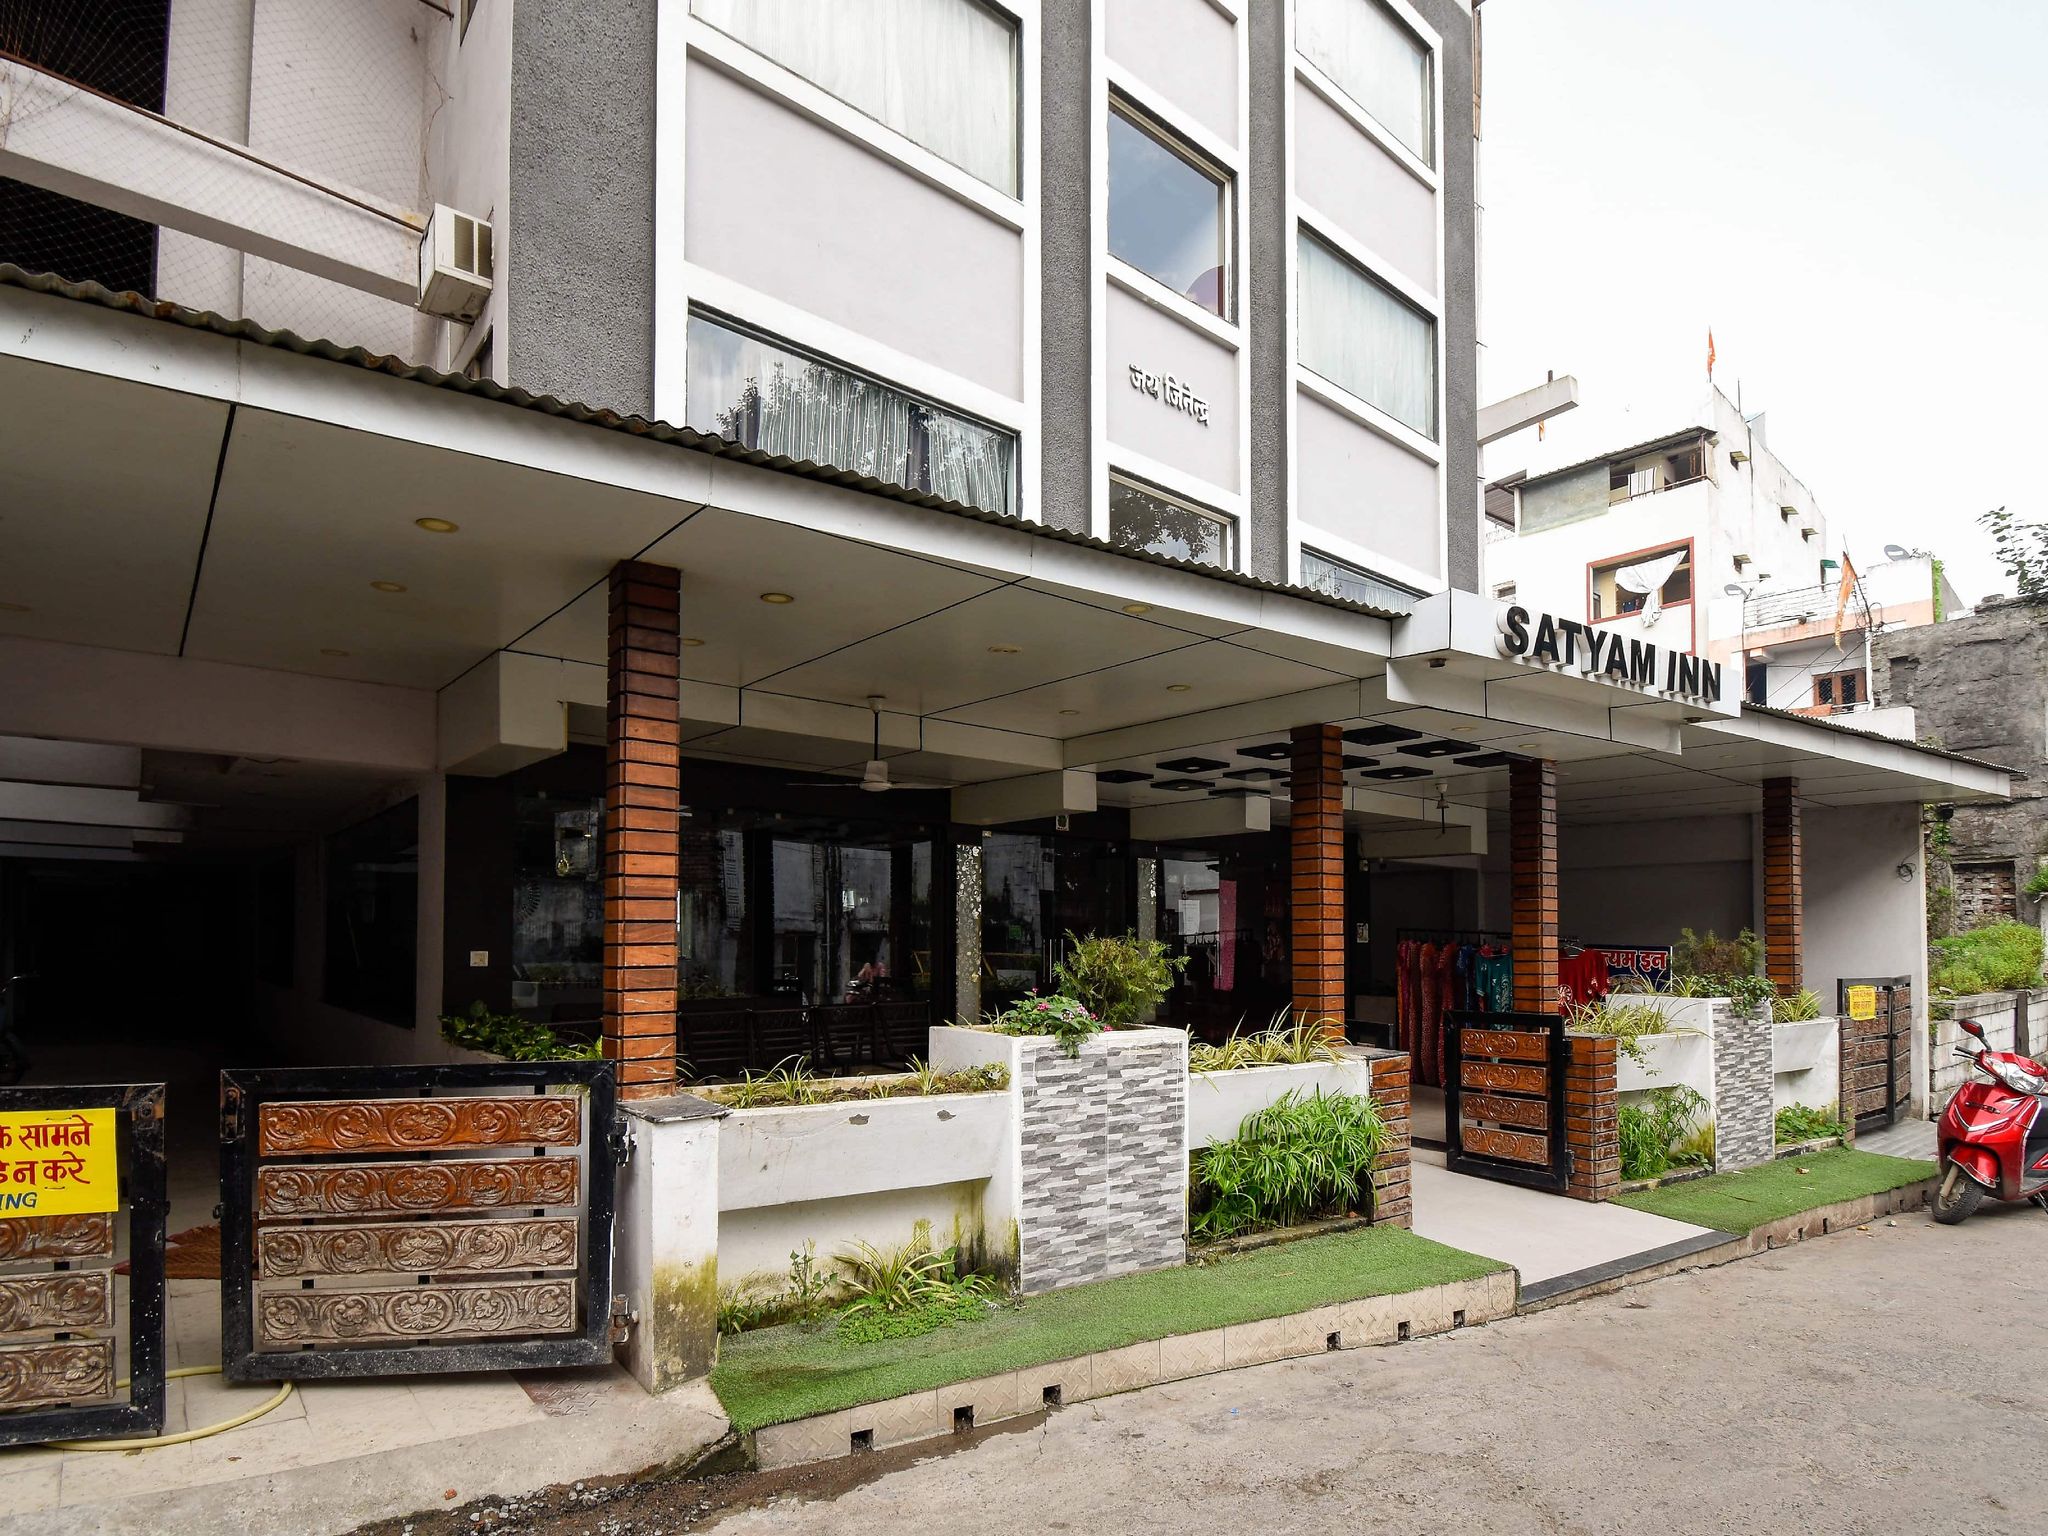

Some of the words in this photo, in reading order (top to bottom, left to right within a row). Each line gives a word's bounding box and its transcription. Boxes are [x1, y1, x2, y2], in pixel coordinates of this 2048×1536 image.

[1129, 363, 1160, 400] जय
[1498, 605, 1656, 686] SATYAM
[1664, 649, 1721, 702] INN
[1639, 950, 1669, 973] इन
[18, 1114, 94, 1151] सामने
[42, 1150, 91, 1184] करे
